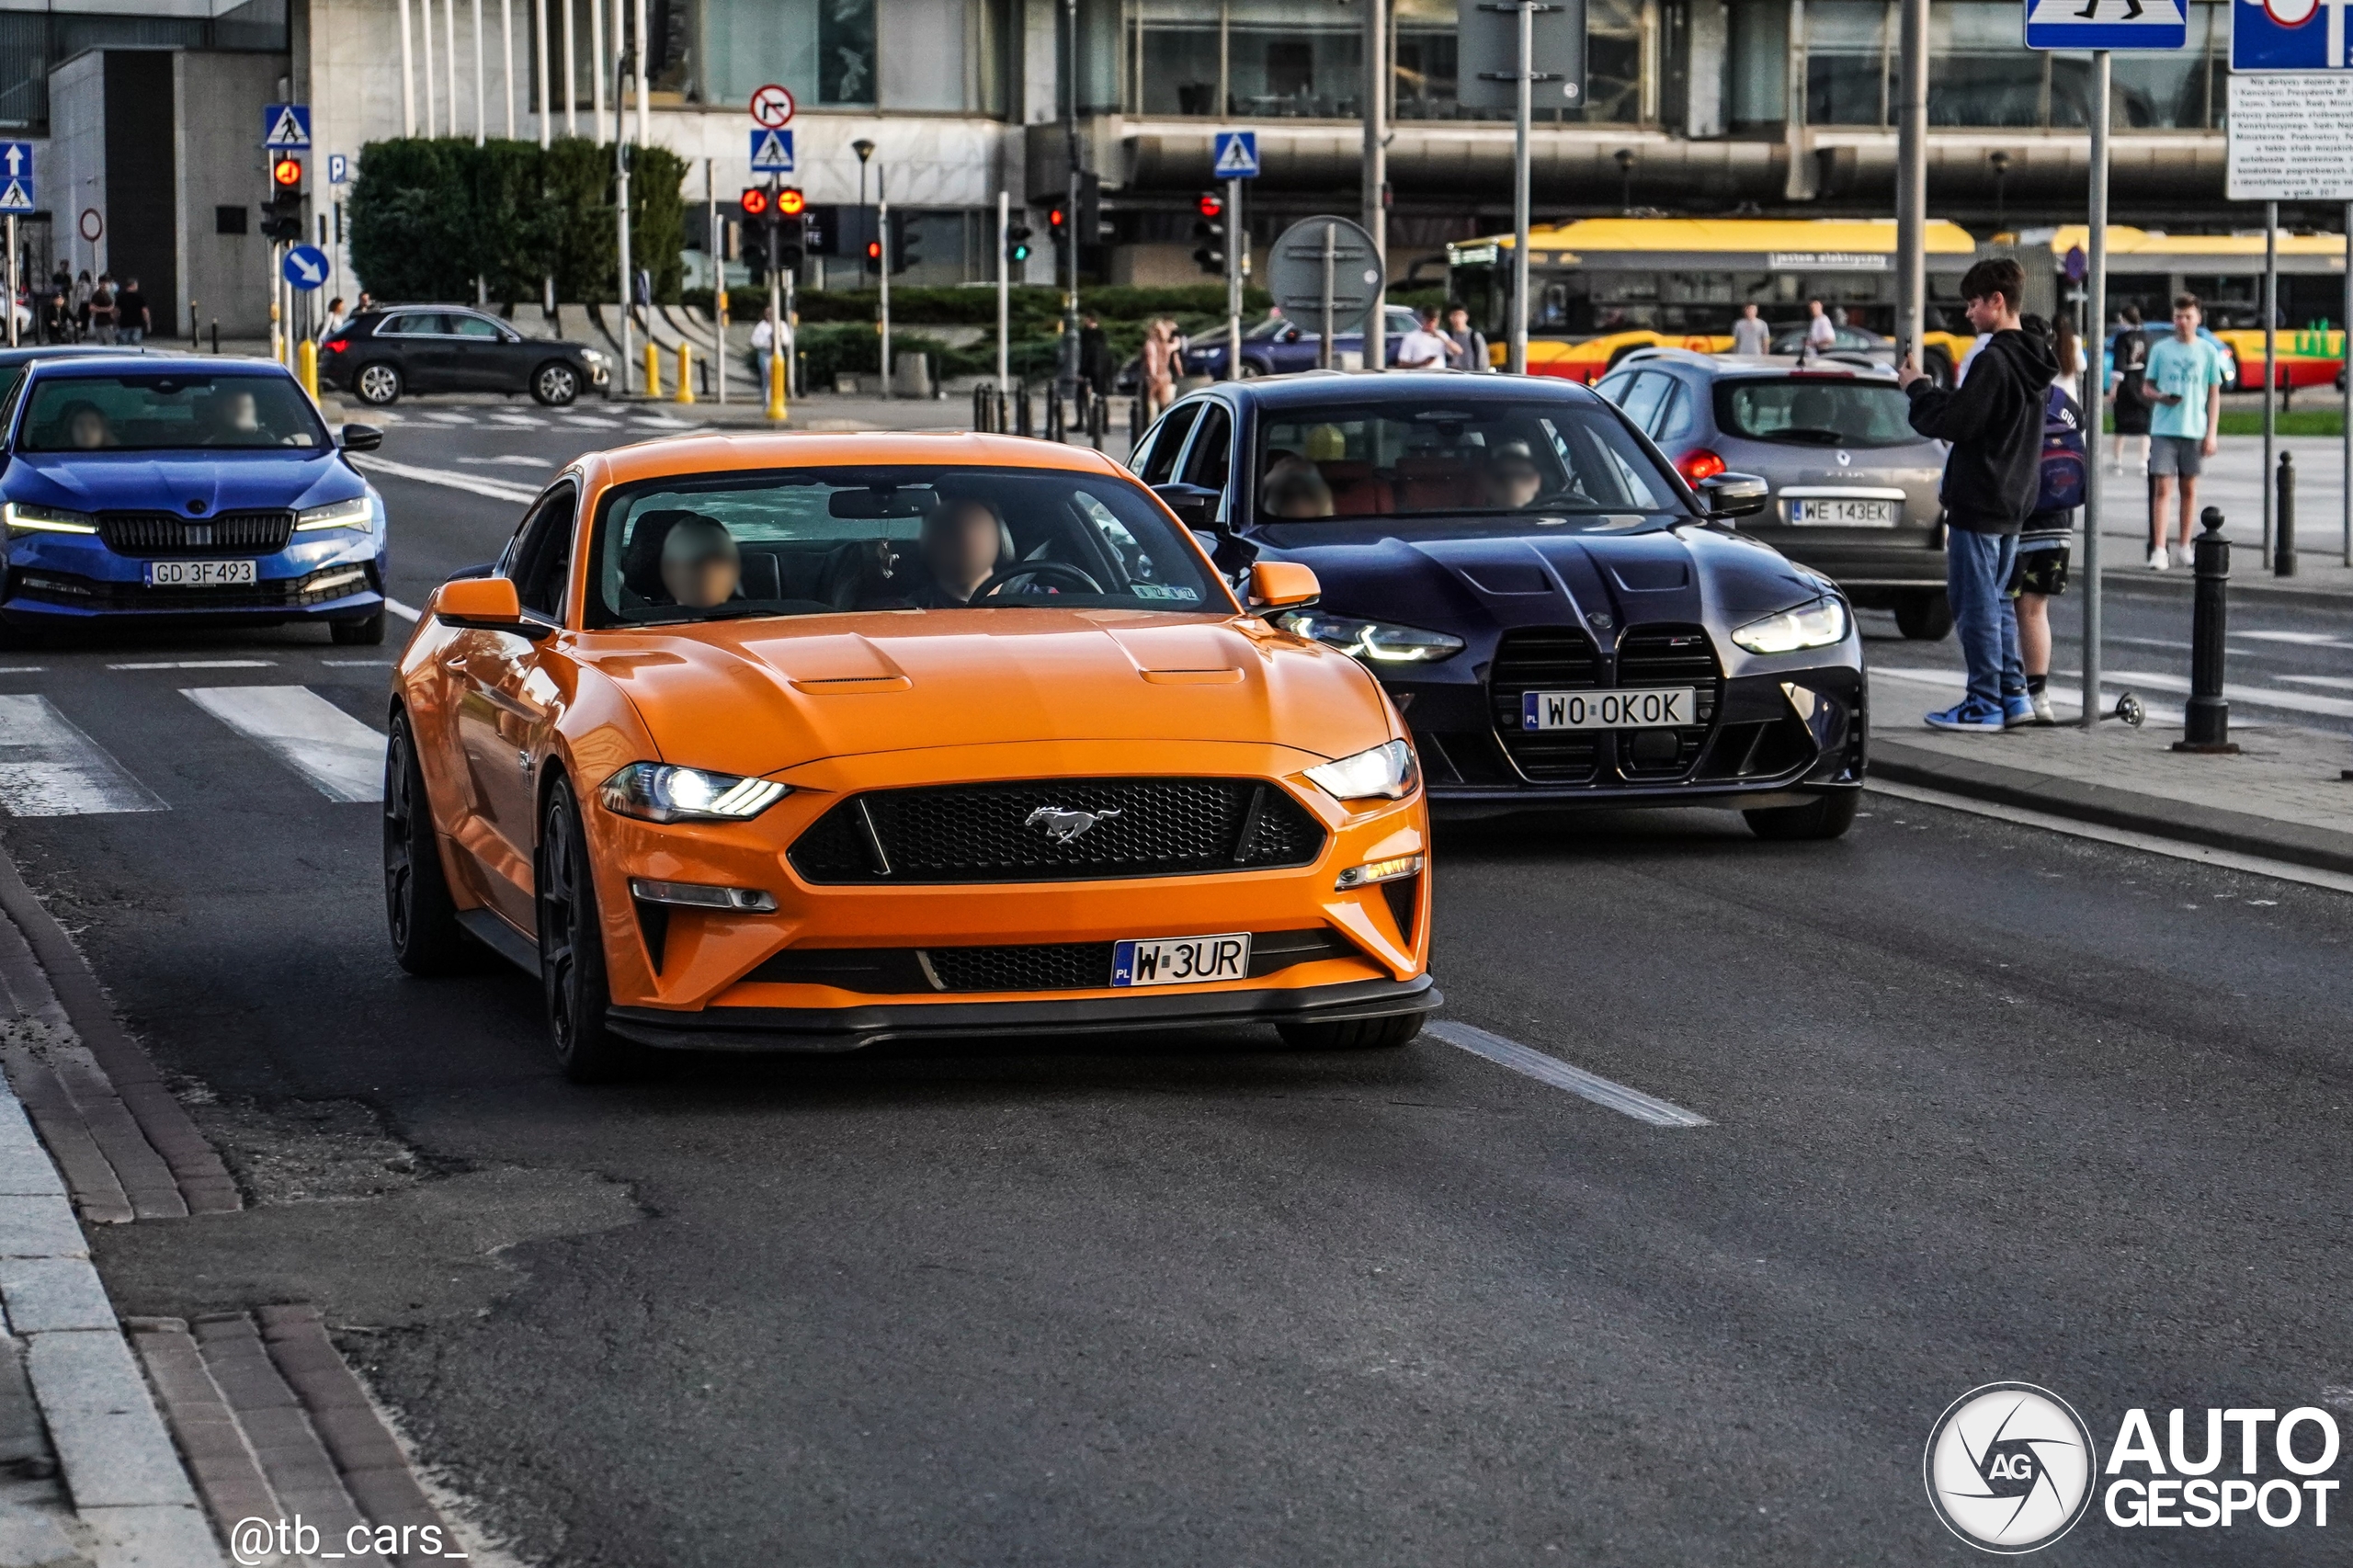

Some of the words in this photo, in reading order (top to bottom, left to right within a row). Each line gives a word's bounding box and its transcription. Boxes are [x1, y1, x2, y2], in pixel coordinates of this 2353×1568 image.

[333, 156, 344, 181] P
[1805, 502, 1829, 520] WE
[1837, 503, 1887, 520] 143EK
[157, 564, 182, 583] GD
[190, 562, 251, 583] 3F493
[1527, 715, 1537, 723] PL
[1137, 946, 1160, 981] W
[1173, 940, 1243, 978] 3UR
[1116, 969, 1131, 979] PL
